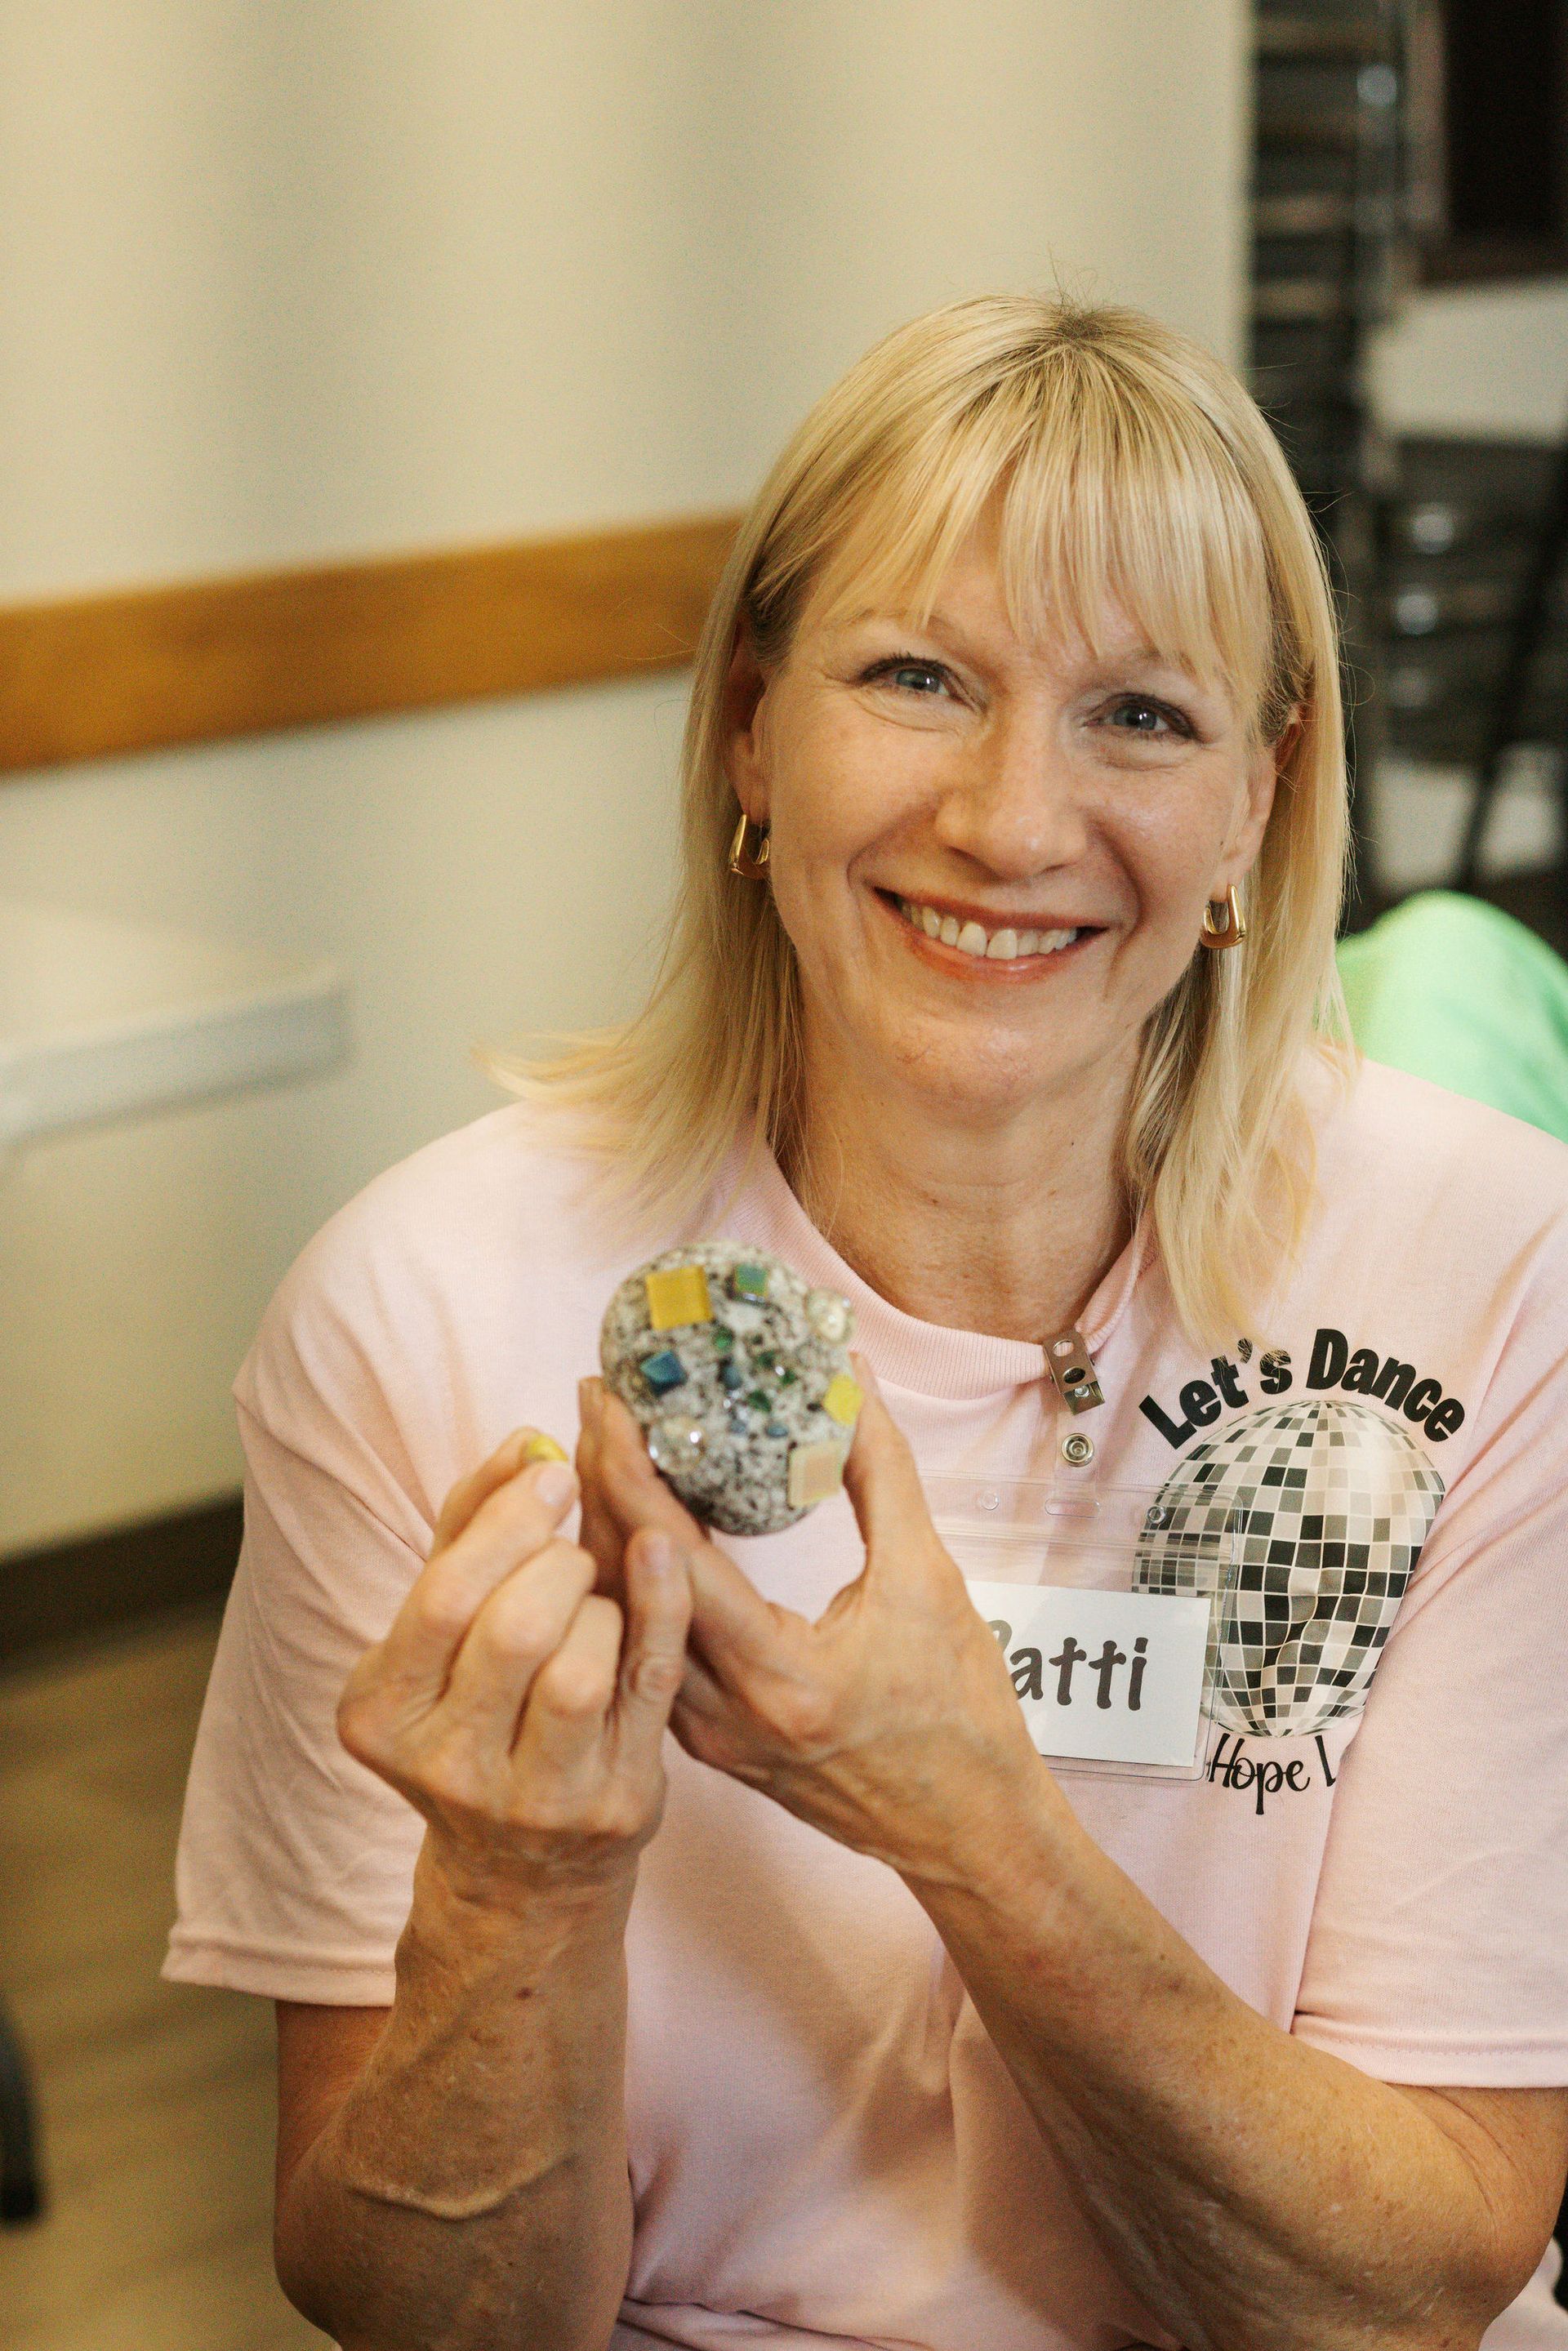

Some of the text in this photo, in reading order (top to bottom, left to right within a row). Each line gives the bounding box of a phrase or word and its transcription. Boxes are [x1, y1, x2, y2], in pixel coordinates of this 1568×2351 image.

[1138, 1328, 1466, 1450] Let's Dance
[1208, 1732, 1311, 1815] Hope
